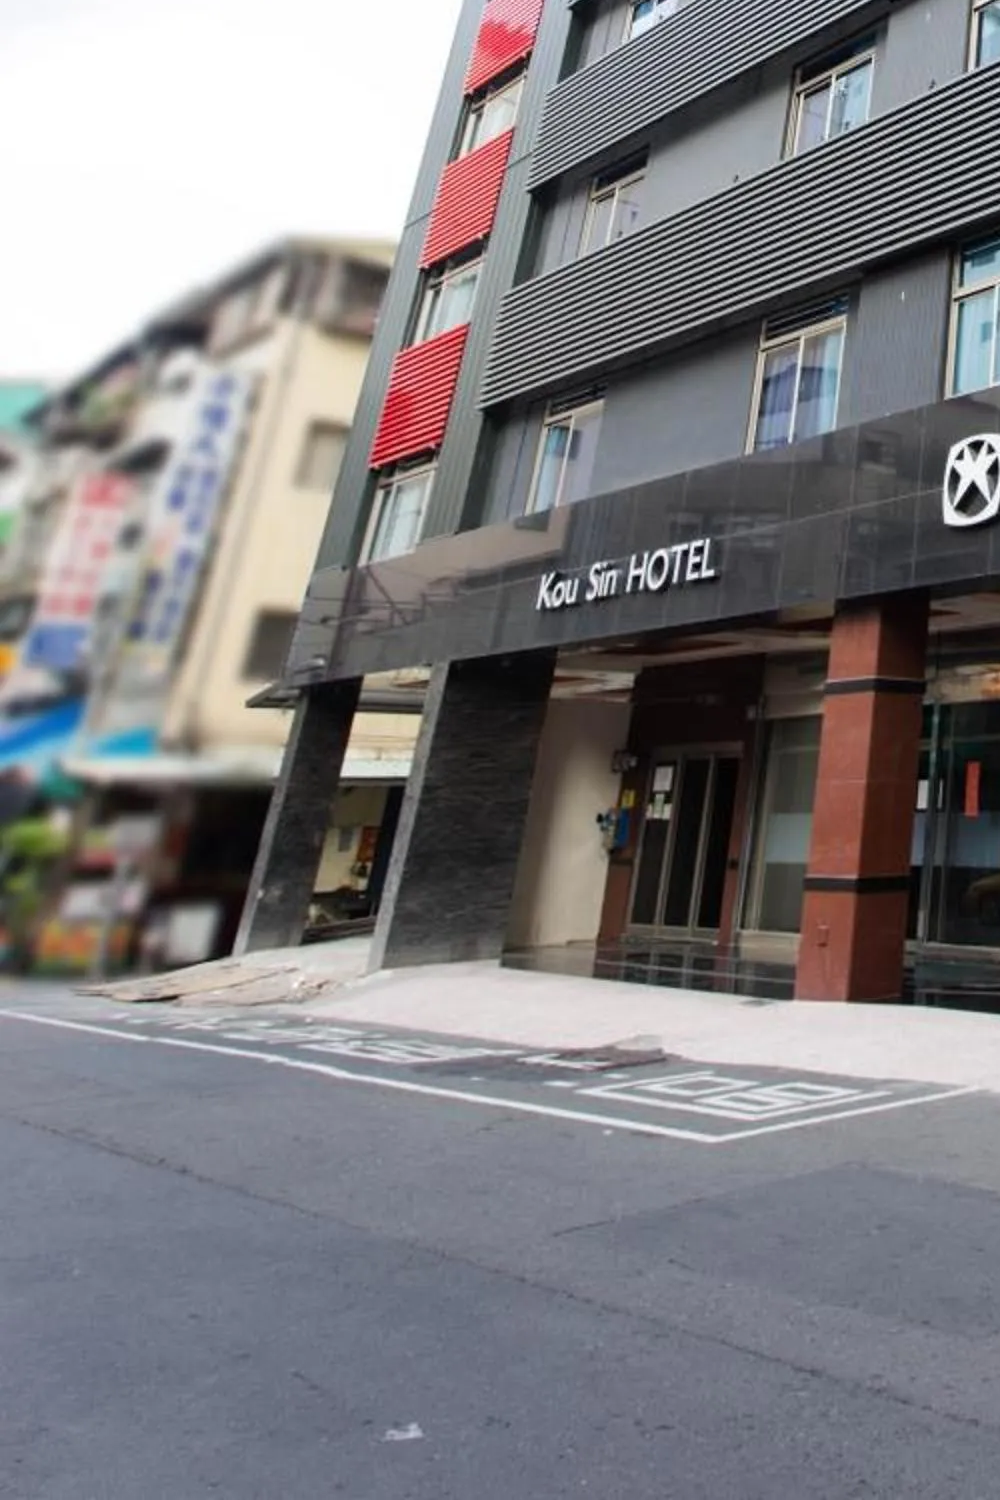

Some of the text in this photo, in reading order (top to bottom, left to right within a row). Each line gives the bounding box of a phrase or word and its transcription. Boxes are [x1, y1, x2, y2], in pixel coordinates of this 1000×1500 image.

[535, 537, 716, 611] Kou Sin HOTEL
